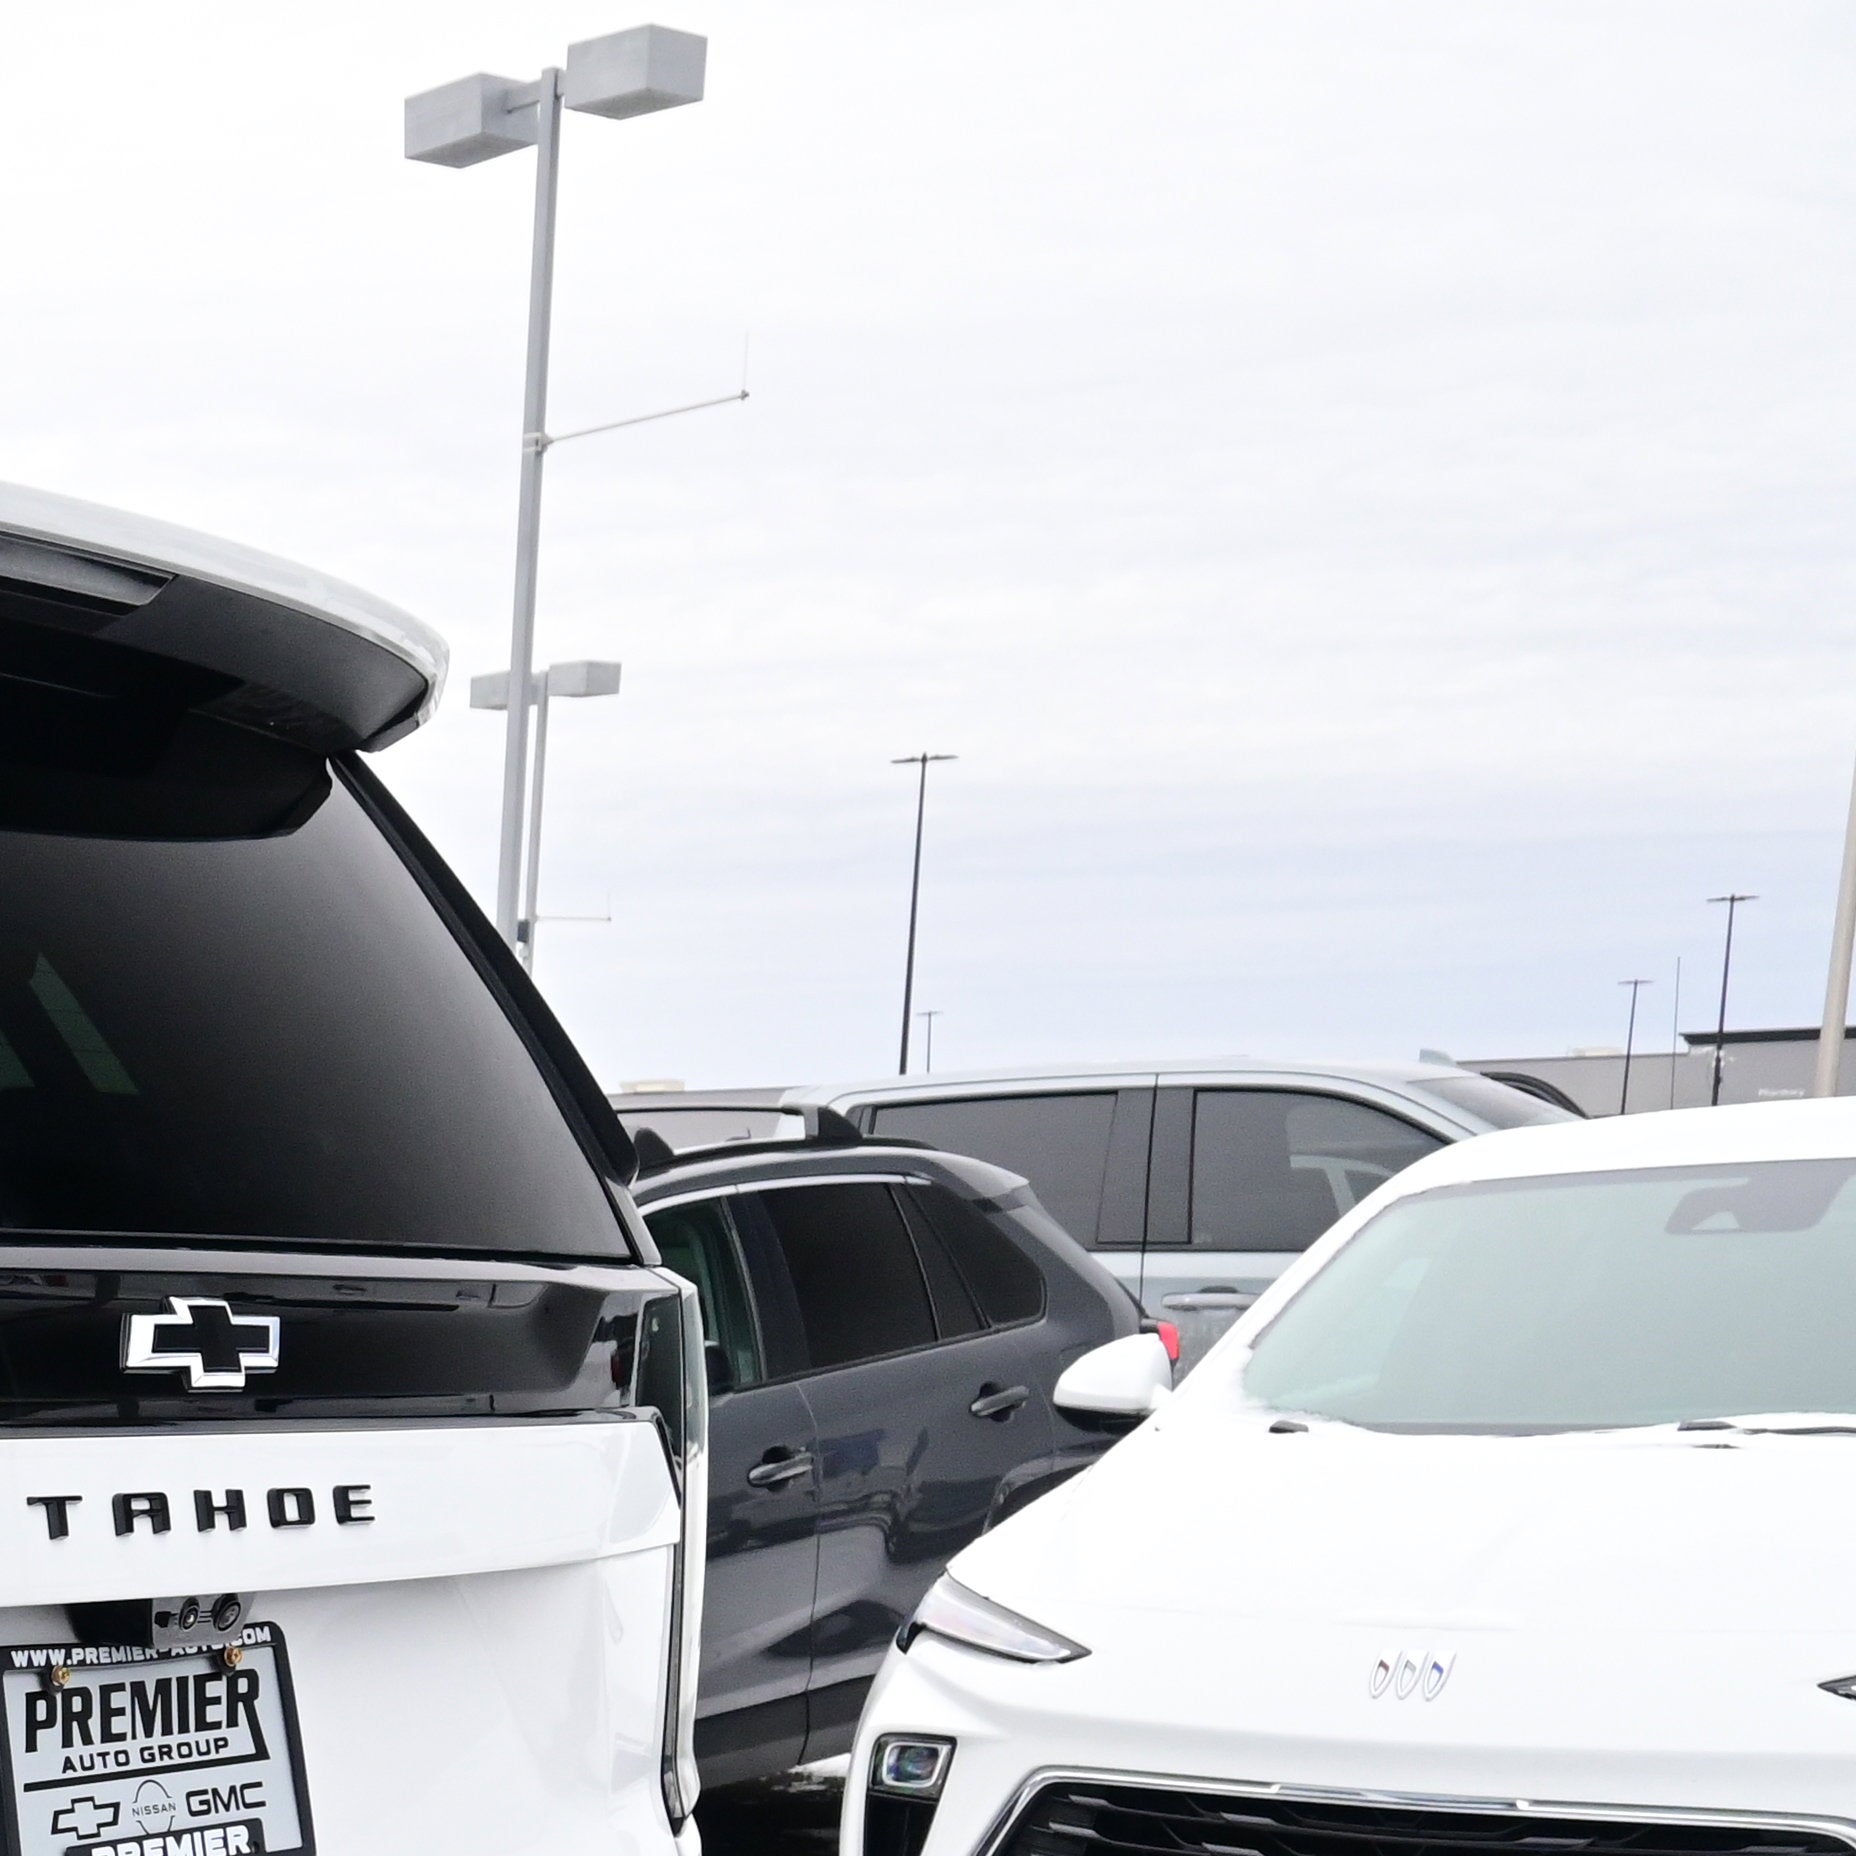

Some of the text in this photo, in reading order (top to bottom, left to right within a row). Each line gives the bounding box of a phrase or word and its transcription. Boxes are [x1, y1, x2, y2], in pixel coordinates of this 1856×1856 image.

[27, 1484, 376, 1541] TAHOE
[25, 1668, 267, 1754] PREMIER
[61, 1736, 229, 1774] AUTO GROUP
[131, 1781, 267, 1817] NISSAN GMC
